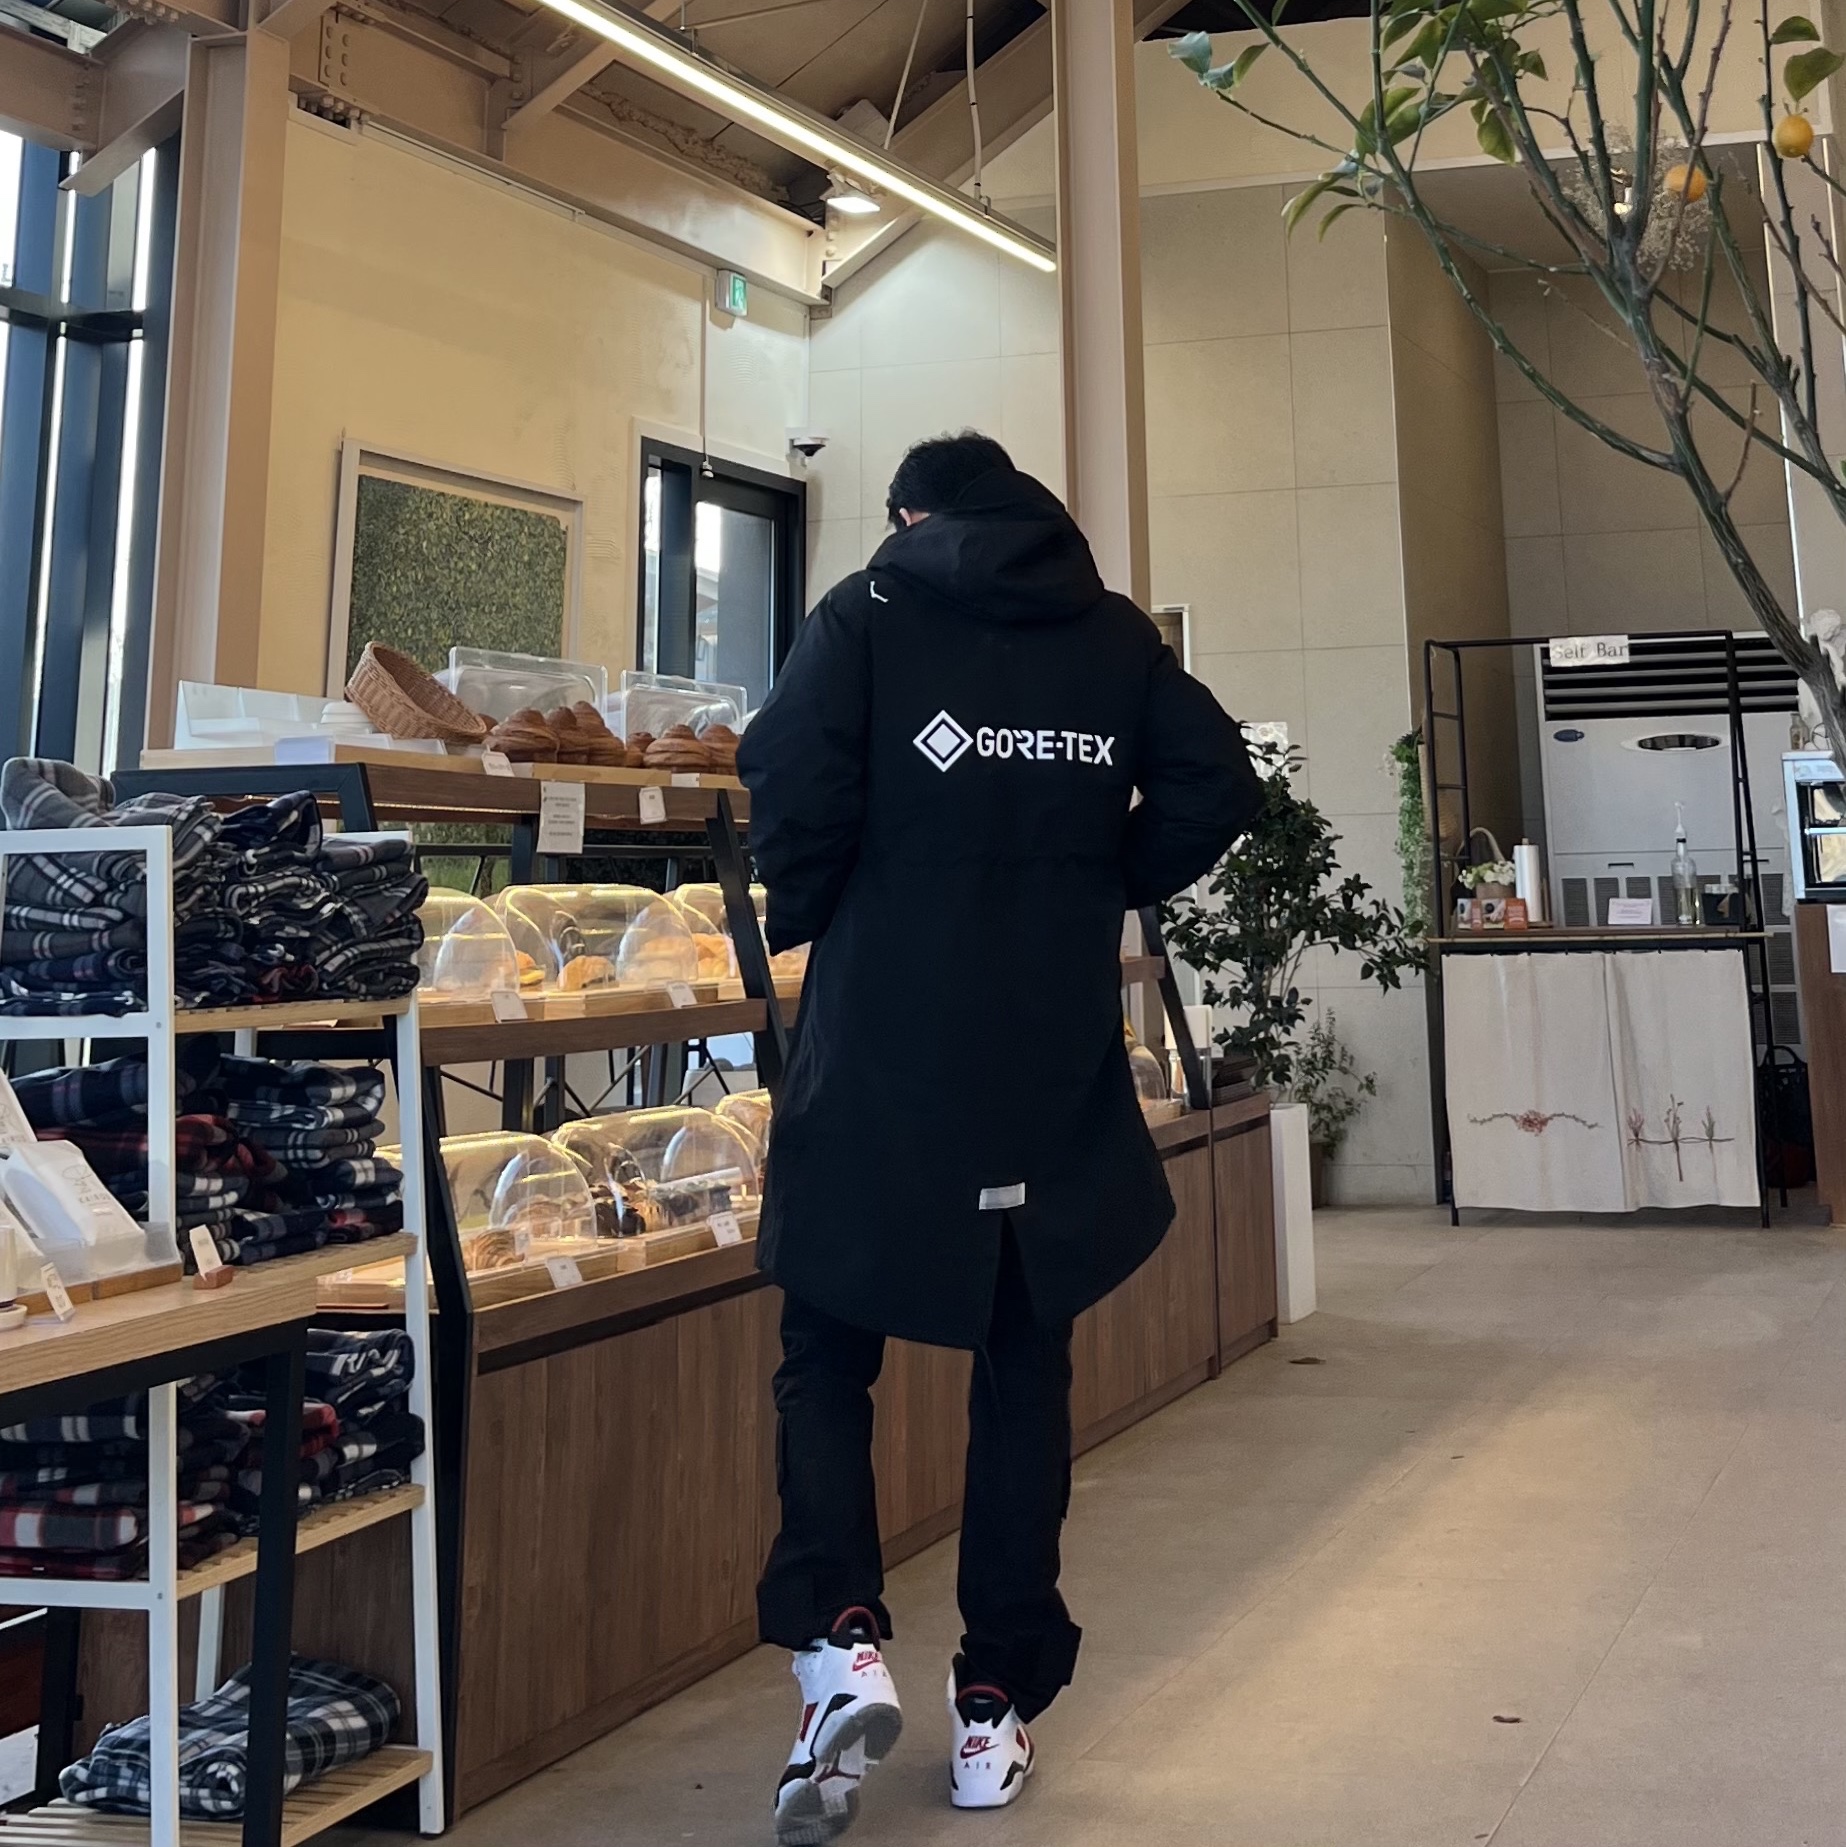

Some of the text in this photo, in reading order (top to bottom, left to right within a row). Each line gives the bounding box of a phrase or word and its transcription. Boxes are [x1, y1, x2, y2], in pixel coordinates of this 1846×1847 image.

[1552, 642, 1628, 659] Self Bar
[976, 726, 1115, 766] GORE-TEX
[966, 1736, 991, 1749] NIKE
[964, 1762, 991, 1770] AIR
